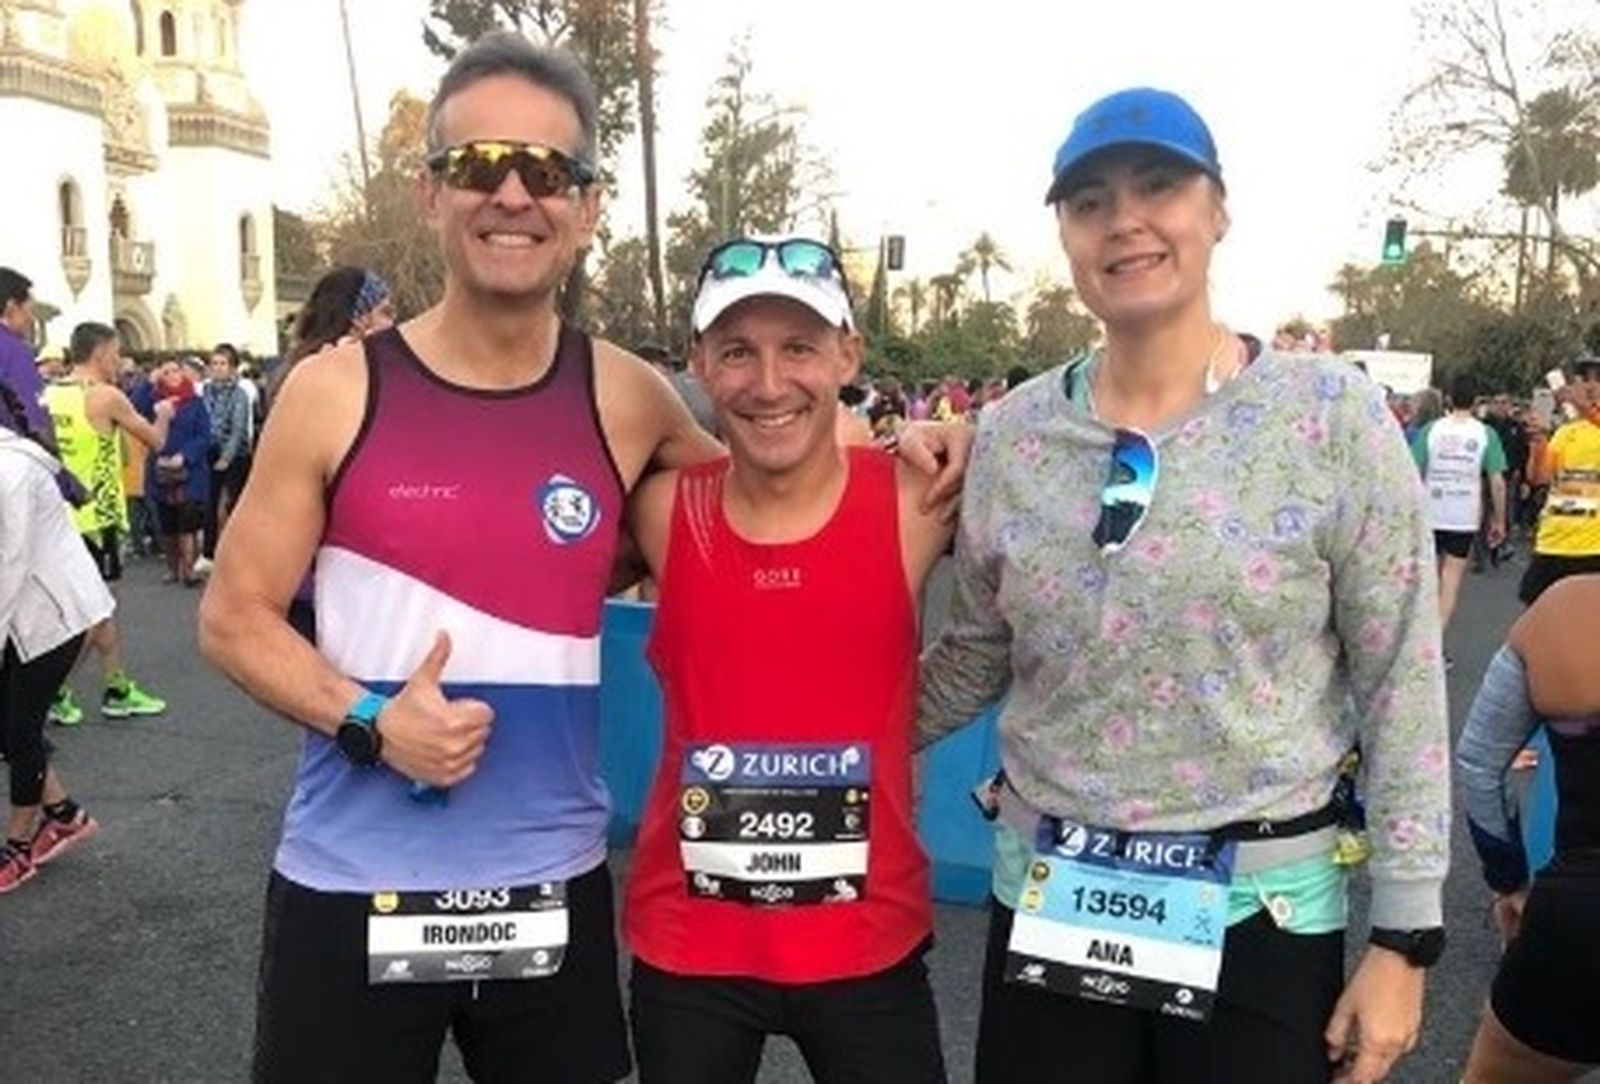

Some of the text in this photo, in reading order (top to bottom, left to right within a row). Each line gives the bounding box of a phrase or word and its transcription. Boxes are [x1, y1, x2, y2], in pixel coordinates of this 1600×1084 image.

[742, 753, 848, 777] ZURICH
[739, 811, 814, 838] 2492
[746, 852, 801, 873] JOHN
[1072, 885, 1168, 925] 13594
[422, 922, 517, 945] IRONDOC
[1086, 939, 1134, 967] ANA
